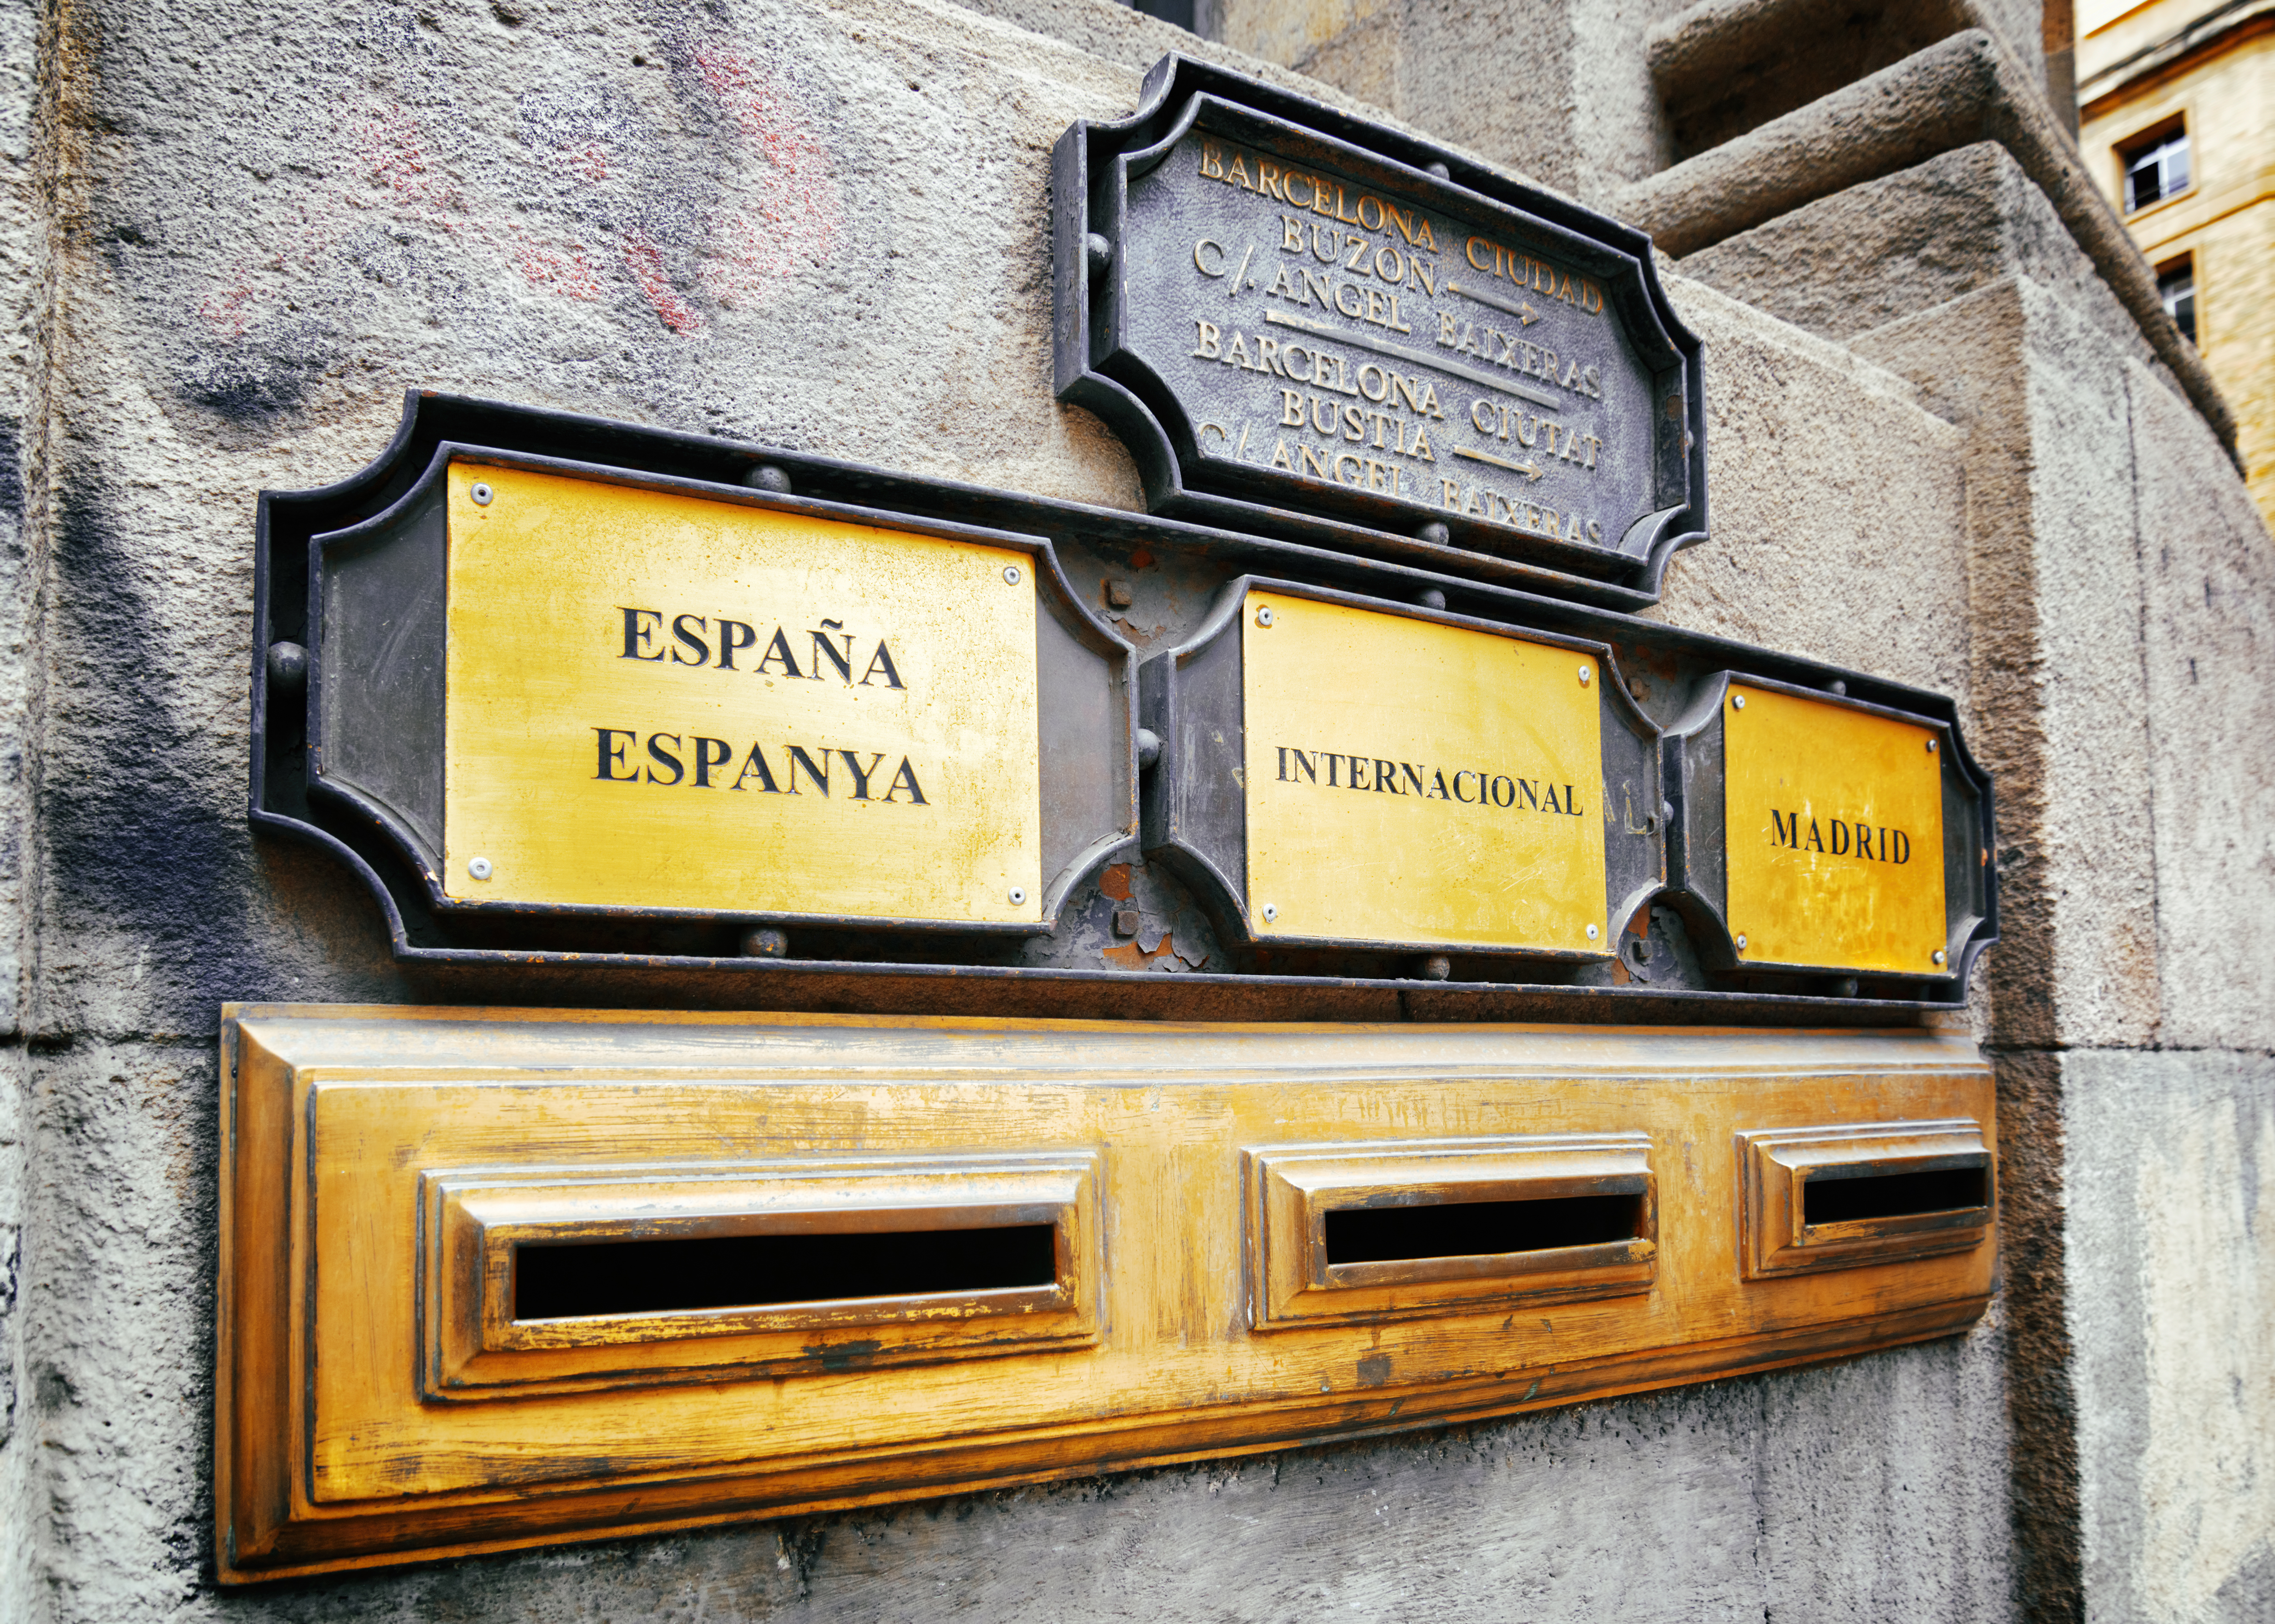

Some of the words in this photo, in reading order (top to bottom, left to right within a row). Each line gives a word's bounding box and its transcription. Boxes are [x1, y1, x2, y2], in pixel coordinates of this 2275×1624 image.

[1198, 142, 1439, 253] BARCELONA
[1466, 236, 1603, 315] CIUDAD
[1280, 214, 1434, 296] BUZON
[1267, 262, 1410, 334] ANGEL
[1436, 310, 1601, 399] BAIXERAS
[1194, 320, 1444, 419] BARCELONA
[1471, 399, 1602, 469] CIUTAT
[1279, 388, 1436, 462] BUSTIA
[1441, 478, 1601, 546] BAIXERAS
[617, 607, 908, 691] ESPAÑA
[591, 727, 931, 806] ESPANYA
[1274, 746, 1583, 817] INTERNACIONAL
[1770, 809, 1911, 865] MADRID
